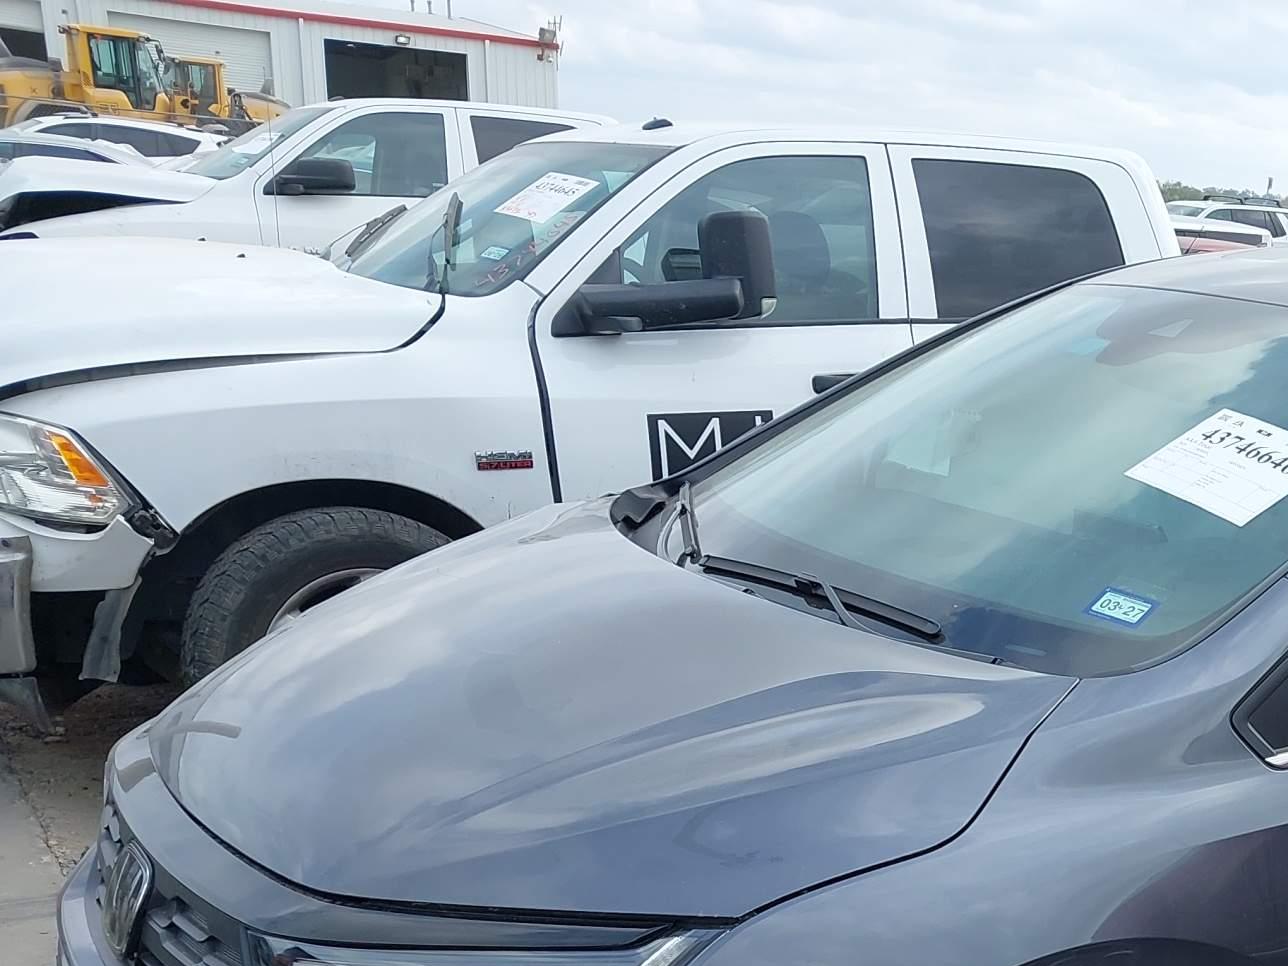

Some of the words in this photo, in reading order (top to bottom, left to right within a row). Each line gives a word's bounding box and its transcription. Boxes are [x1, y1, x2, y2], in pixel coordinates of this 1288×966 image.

[475, 450, 533, 461] HEMI
[1100, 598, 1121, 611] 03
[1122, 605, 1145, 619] 27
